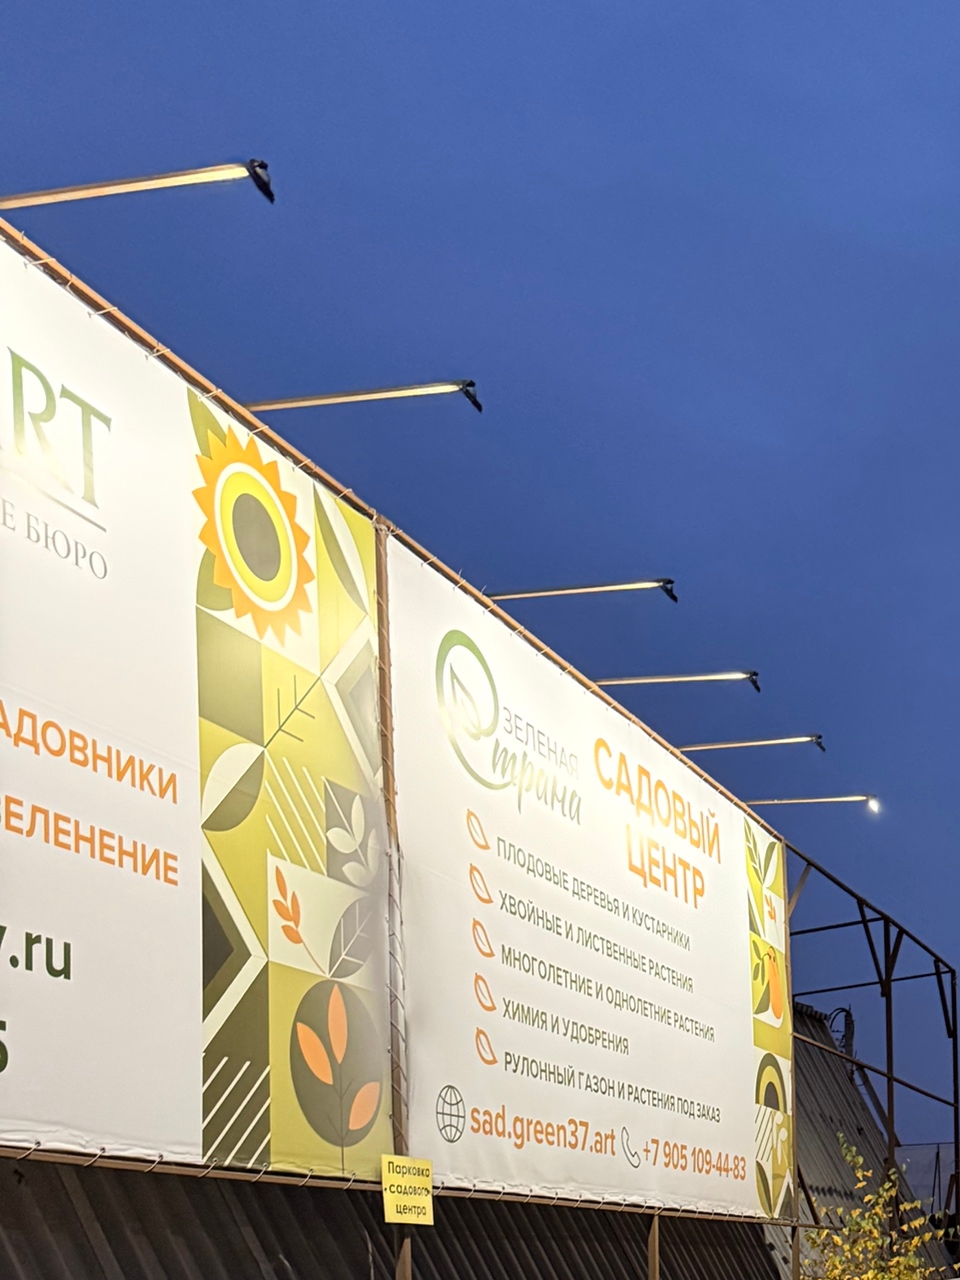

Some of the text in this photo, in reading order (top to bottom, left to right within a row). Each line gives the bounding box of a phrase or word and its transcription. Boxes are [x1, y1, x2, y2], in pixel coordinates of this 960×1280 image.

[0, 346, 112, 509] RT
[26, 512, 108, 580] БЮРО
[503, 706, 579, 780] ЗЕЛЕНАЯ
[594, 737, 722, 864] САДОВЫЙ
[0, 794, 178, 886] ЕЛЕНЕНИЕ
[626, 823, 705, 909] ЦЕНТР
[497, 836, 691, 951] ПЛОДОВЫЕ ДЕРЕВЬЯ И КУСТАРНИКИ
[0, 925, 71, 980] .ru
[499, 889, 694, 994] ХВОЙНЫЕ И ЛИСТВЕННЫЕ РАСТЕНИЯ
[501, 944, 715, 1043] МНОГОЛЕТНИЕ И ОДНОЛЕТНИЕ РАСТЕНИЯ
[502, 997, 630, 1056] ХИМИЯ И УДОБРЕНИЯ
[504, 1051, 721, 1124] РУЛОННЫЙ ГАЗОН И РАСТЕНИЯ ПОД ЗАКАЗ
[470, 1104, 616, 1156] sad.green37.art
[643, 1138, 747, 1181] +7 905 109-44-83
[387, 1161, 430, 1178] Парковка
[388, 1184, 430, 1197] садового
[395, 1203, 427, 1218] центра
